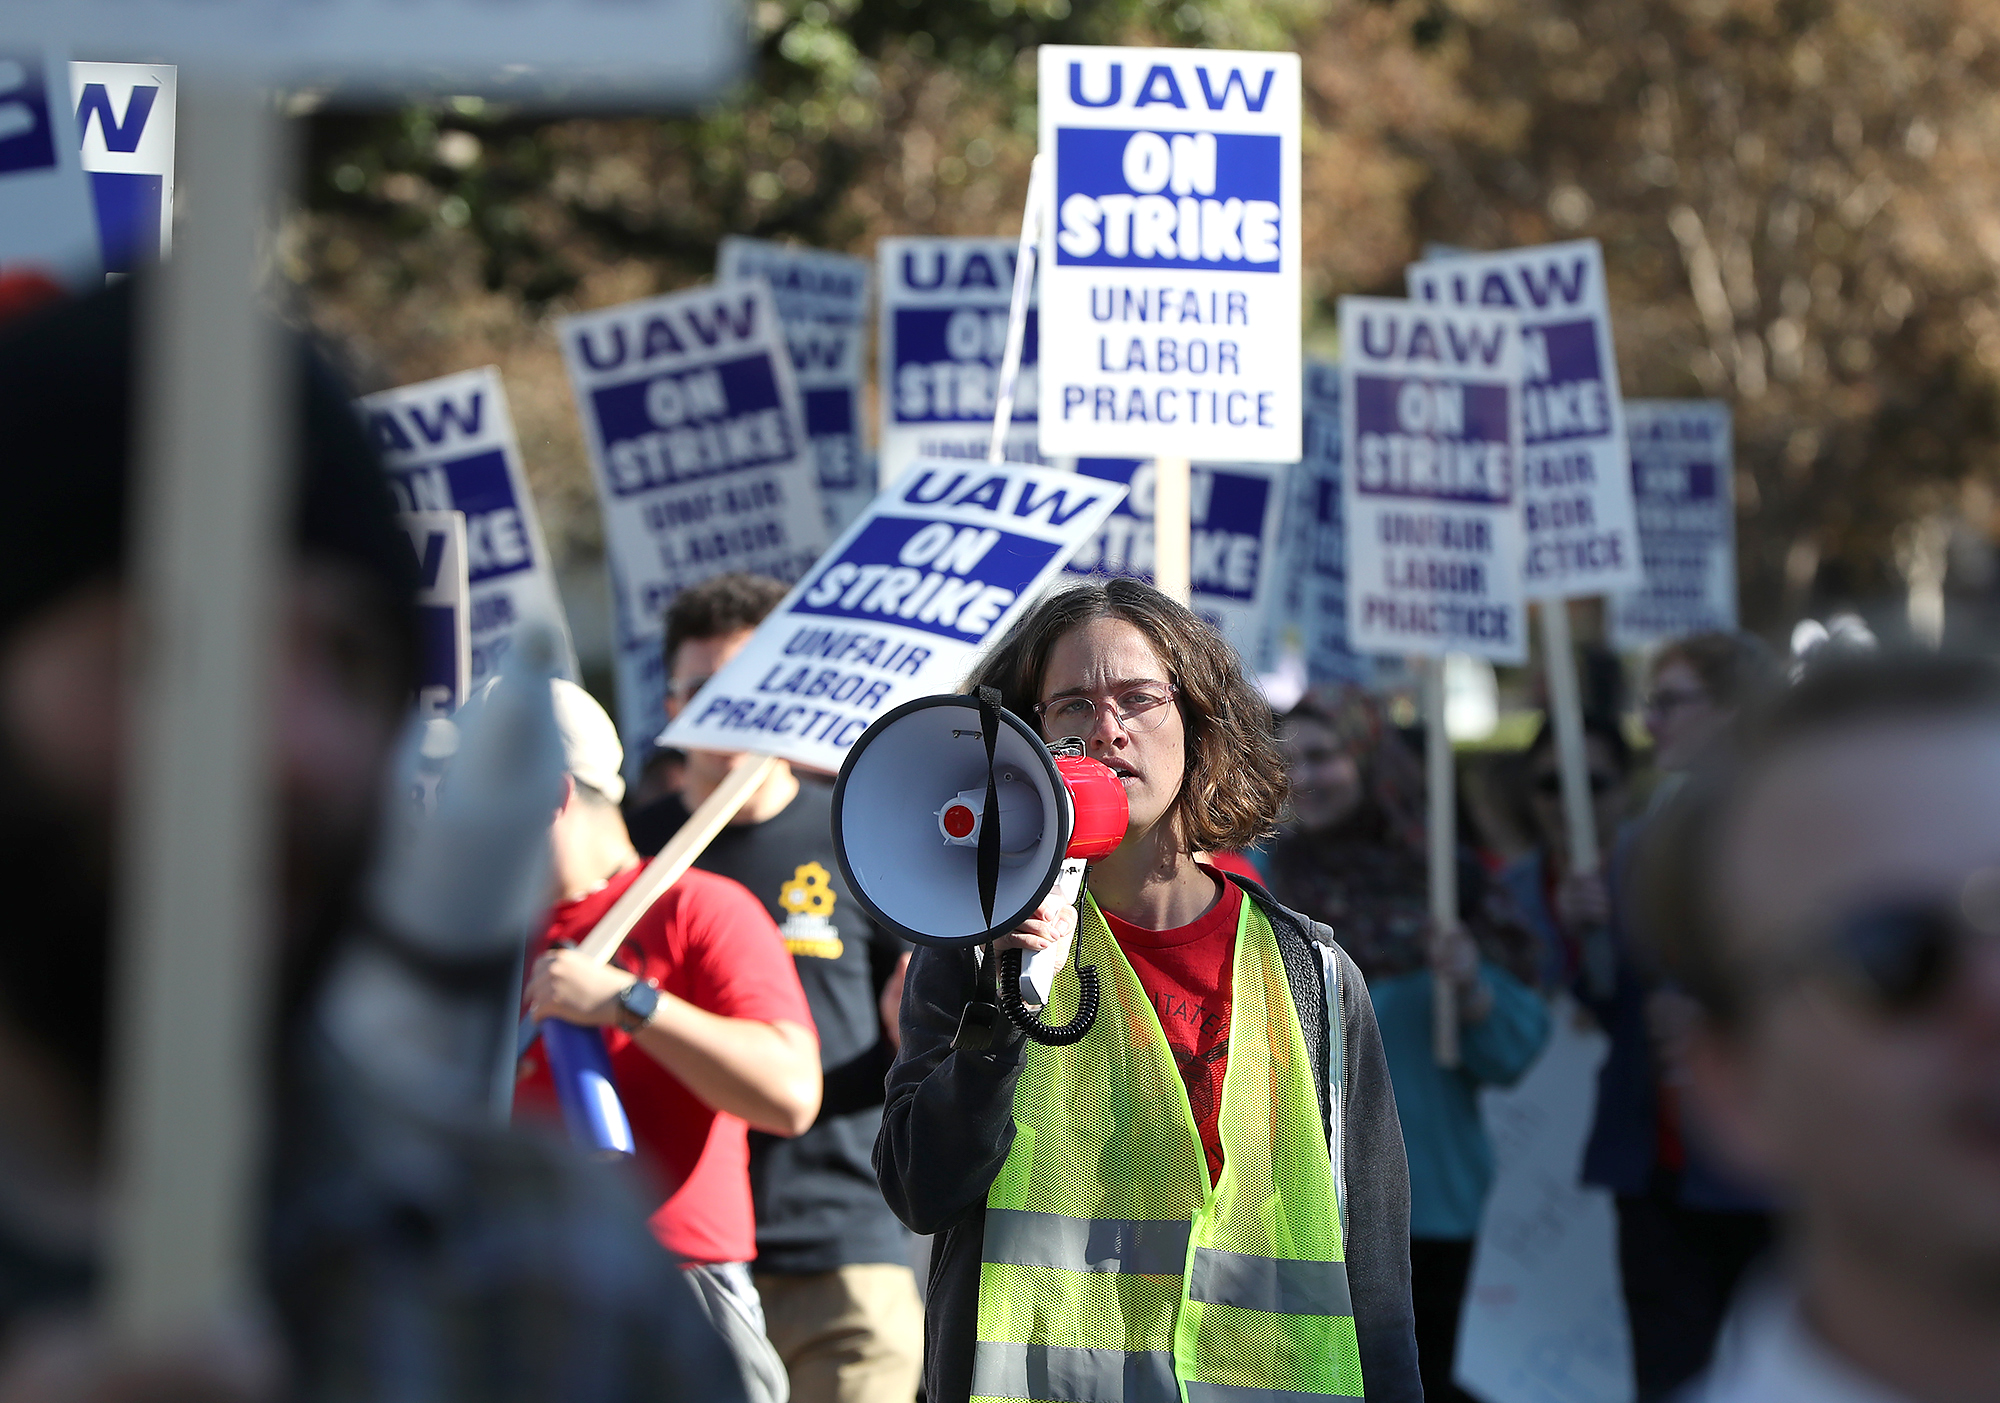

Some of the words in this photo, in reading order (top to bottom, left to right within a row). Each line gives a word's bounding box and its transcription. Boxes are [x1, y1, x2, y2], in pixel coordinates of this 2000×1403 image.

[1068, 62, 1276, 113] UAW
[1121, 130, 1218, 197] ON
[1056, 192, 1282, 264] STRIKE
[1090, 286, 1249, 326] UNFAIR
[1424, 257, 1587, 308] UAW
[579, 294, 757, 371] UAW
[1098, 336, 1240, 376] LABOR
[1361, 314, 1506, 366] UAW
[370, 391, 483, 452] AW
[643, 364, 730, 430] ON
[1062, 384, 1275, 430] PRACTICE
[1397, 378, 1465, 440] ON
[608, 408, 788, 490] STRIKE
[1359, 432, 1510, 497] STRIKE
[903, 469, 1100, 527] UAW
[896, 520, 1002, 578] ON
[803, 560, 1016, 636] STRIKE
[783, 624, 933, 678] UNFAIR
[756, 662, 893, 710] LABOR
[694, 694, 870, 748] PRACTIC
